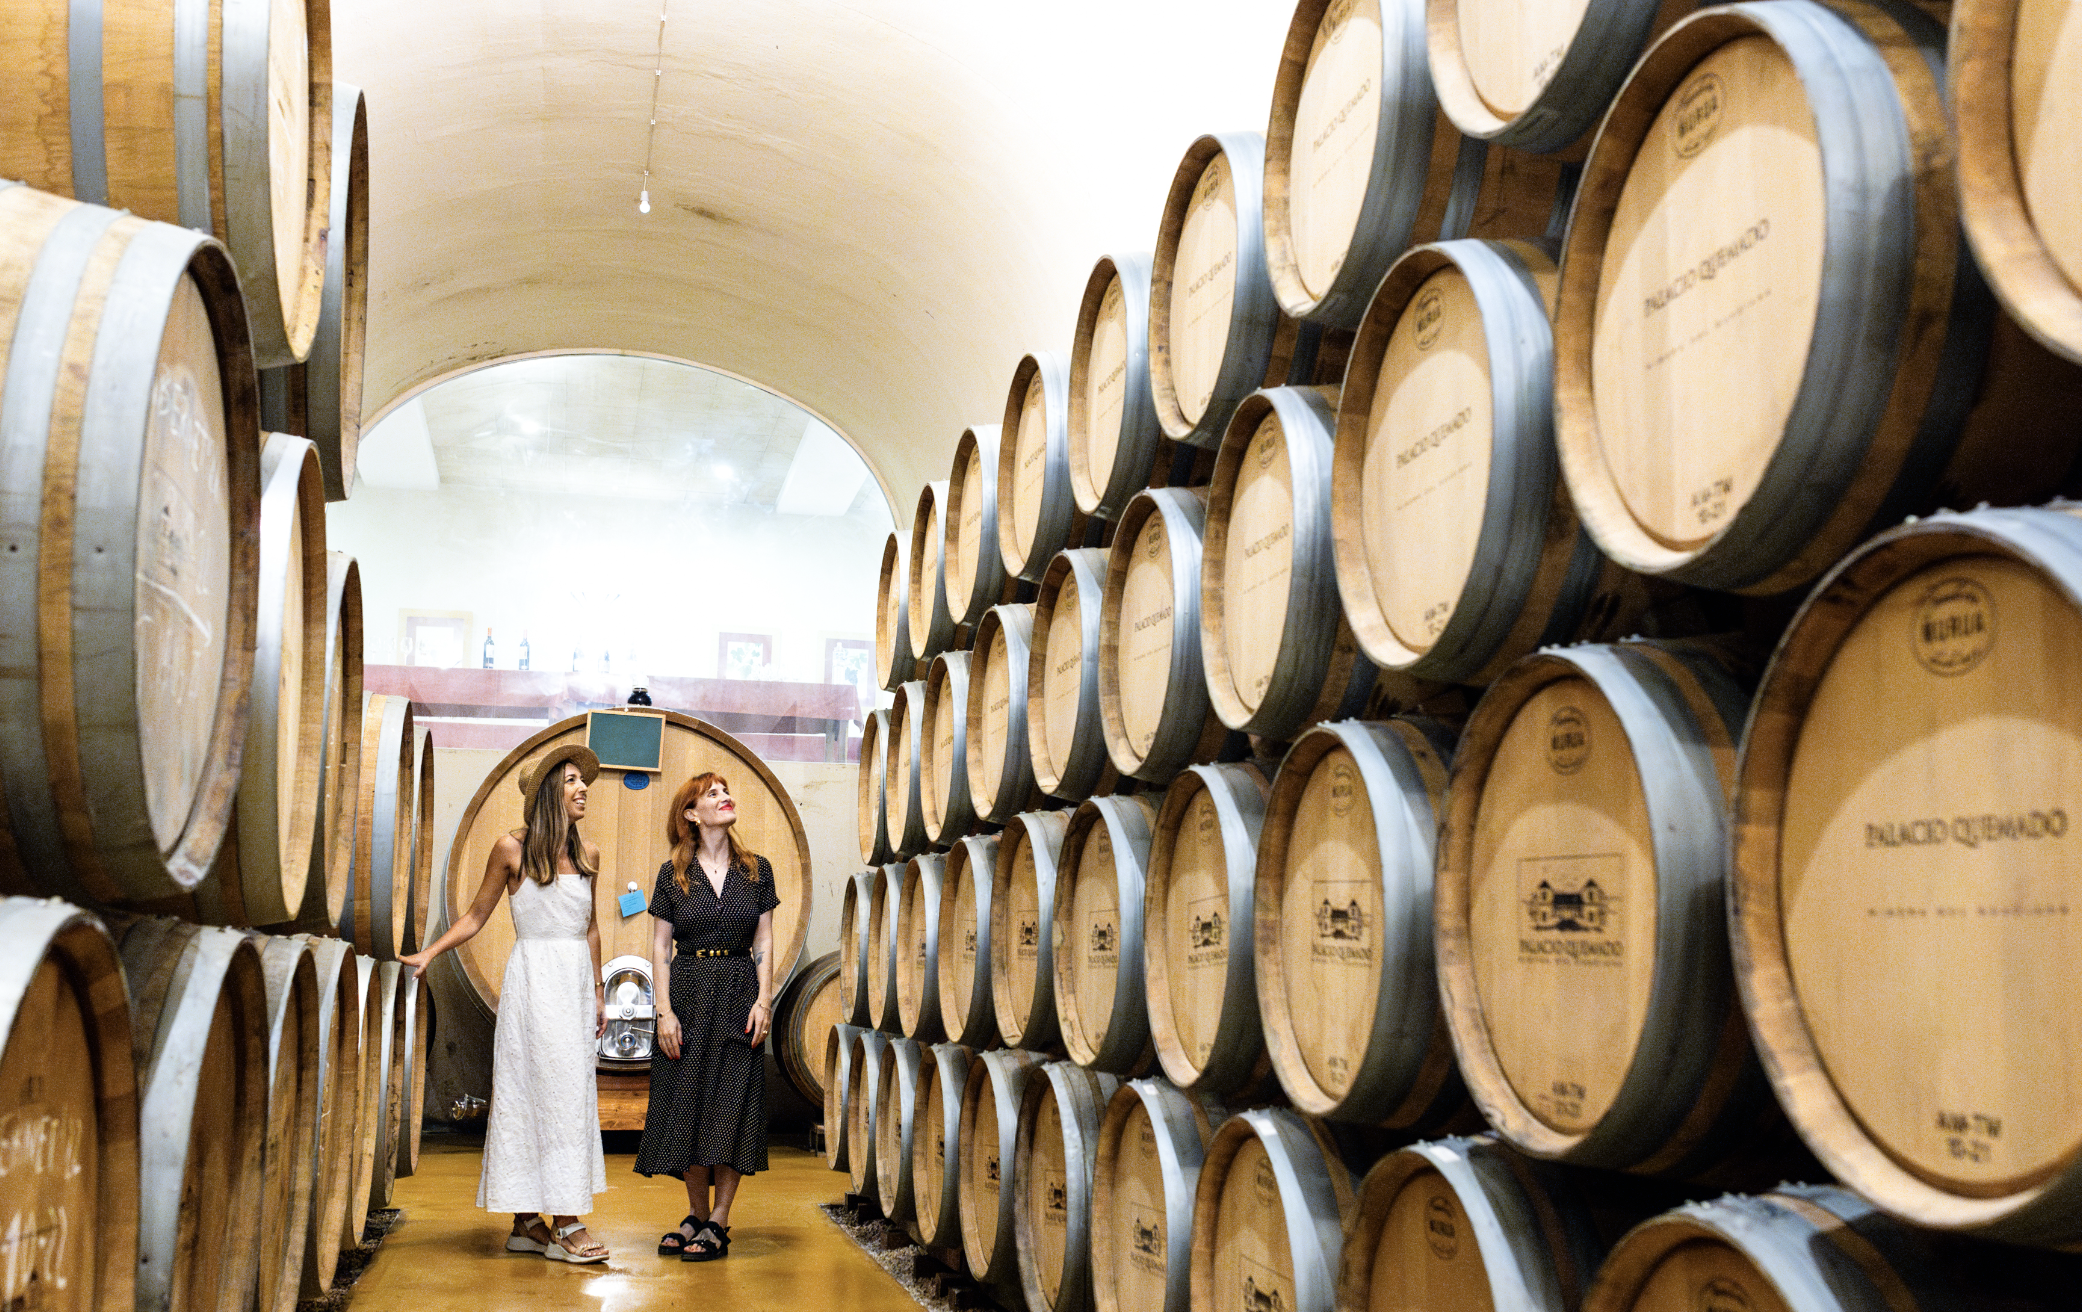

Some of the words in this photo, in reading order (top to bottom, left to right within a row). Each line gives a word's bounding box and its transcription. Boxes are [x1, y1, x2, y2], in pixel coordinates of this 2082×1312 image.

[1644, 268, 1698, 318] PALACIO
[1699, 217, 1771, 281] QUEMADO
[1396, 436, 1429, 470] PALACIO
[1430, 406, 1472, 448] QUEMADO
[1865, 818, 1948, 849] PALACIO
[1951, 807, 2068, 850] QUEMADO
[1519, 939, 1563, 955] PALACIO
[1563, 940, 1623, 959] QUEMADO
